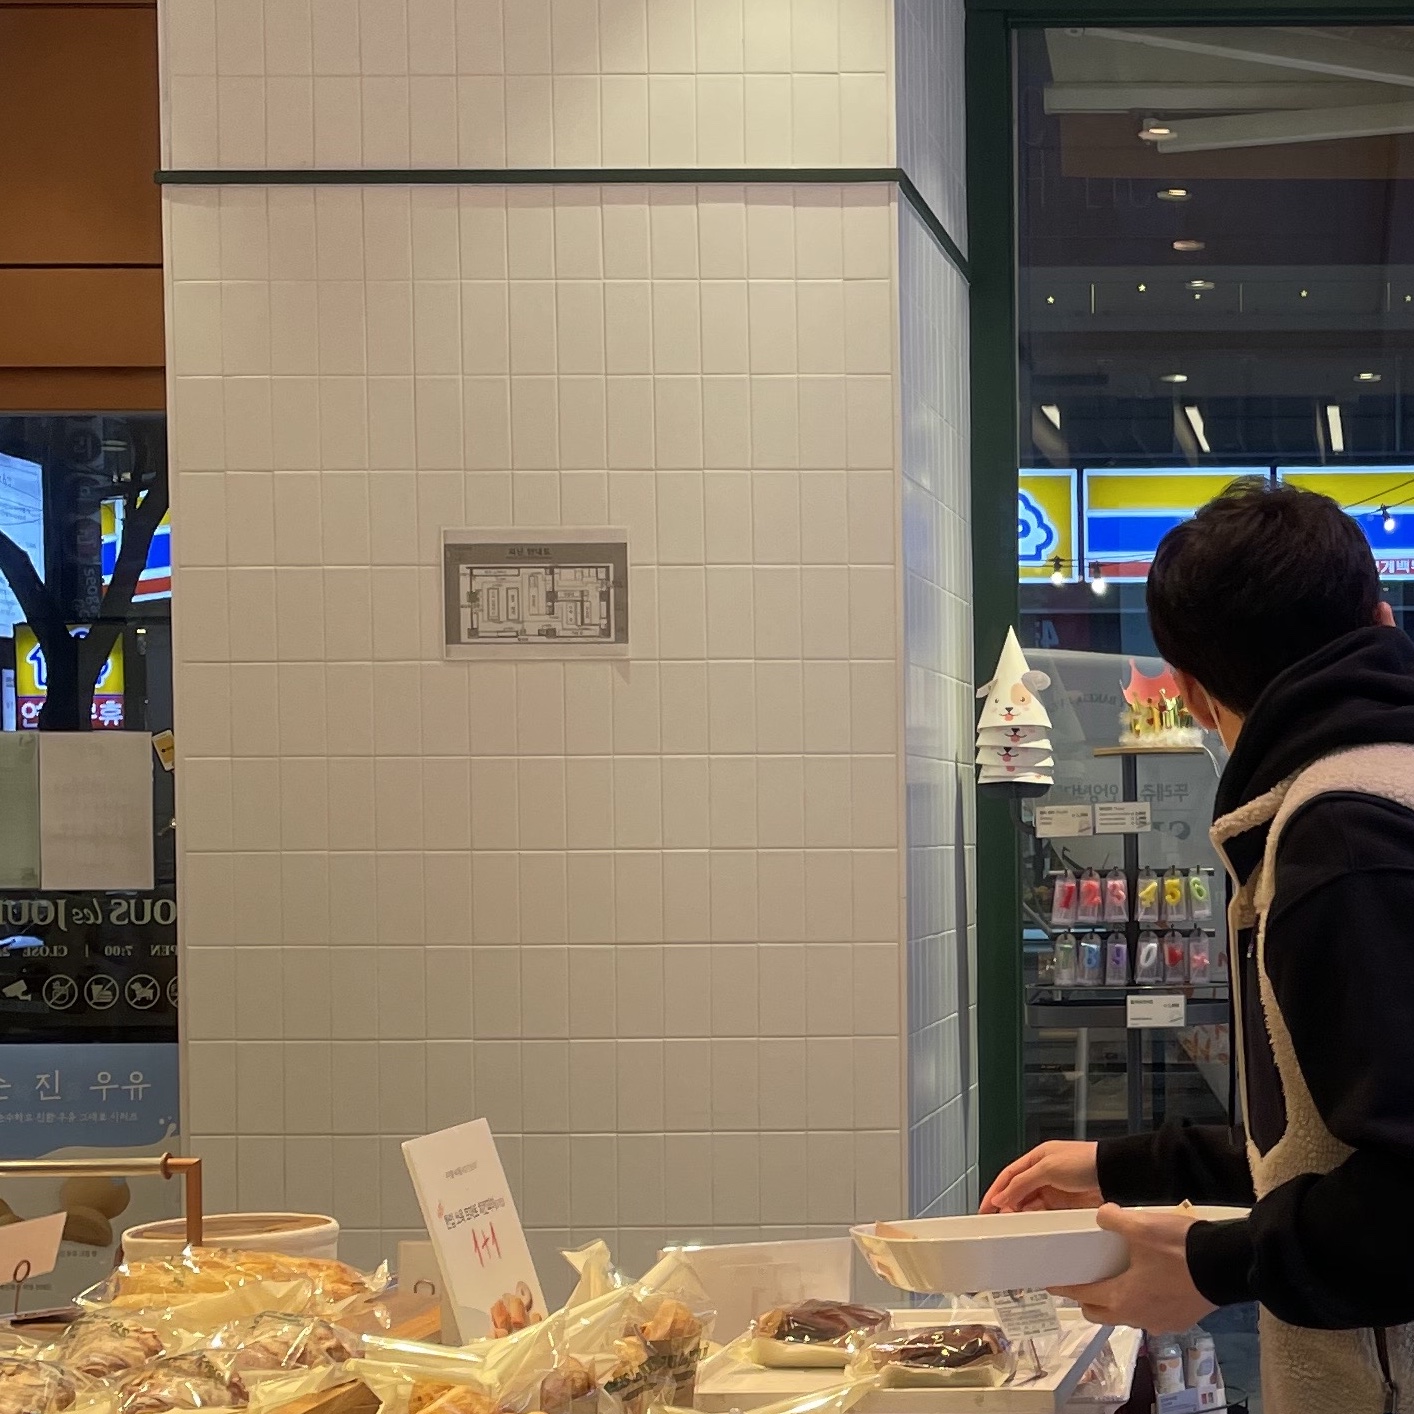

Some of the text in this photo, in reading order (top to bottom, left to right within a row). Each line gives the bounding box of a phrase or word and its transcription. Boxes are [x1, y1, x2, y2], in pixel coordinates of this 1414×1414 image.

[1165, 878, 1181, 906] 5
[1190, 876, 1207, 901] 6
[1140, 943, 1158, 968] 0
[35, 1070, 62, 1101] 진
[89, 1071, 152, 1102] 우유
[471, 1220, 502, 1268] 1+1
